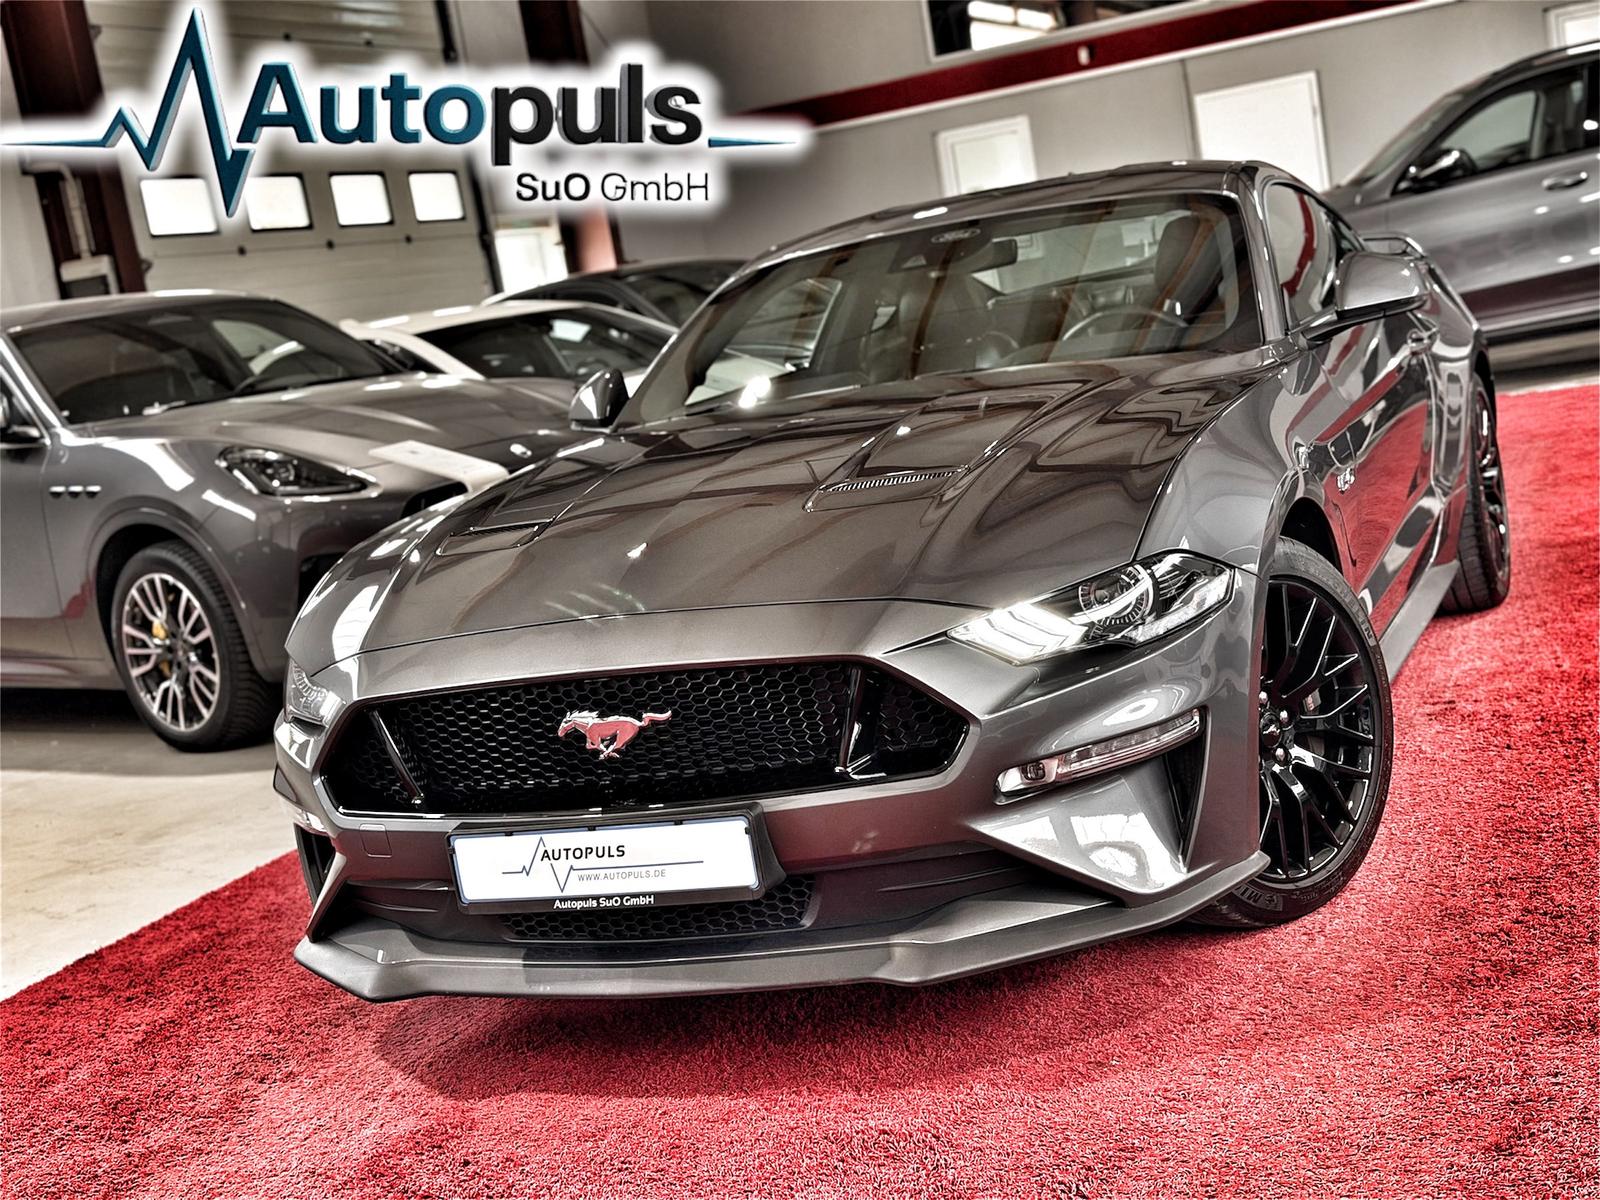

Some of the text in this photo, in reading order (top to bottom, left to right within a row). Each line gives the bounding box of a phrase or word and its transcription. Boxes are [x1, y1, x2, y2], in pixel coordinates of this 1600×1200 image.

[540, 845, 626, 861] AUTOPULS
[578, 869, 666, 881] WWW.AUTOPULS.DE
[553, 895, 654, 910] Autopuls SuO GmbH
